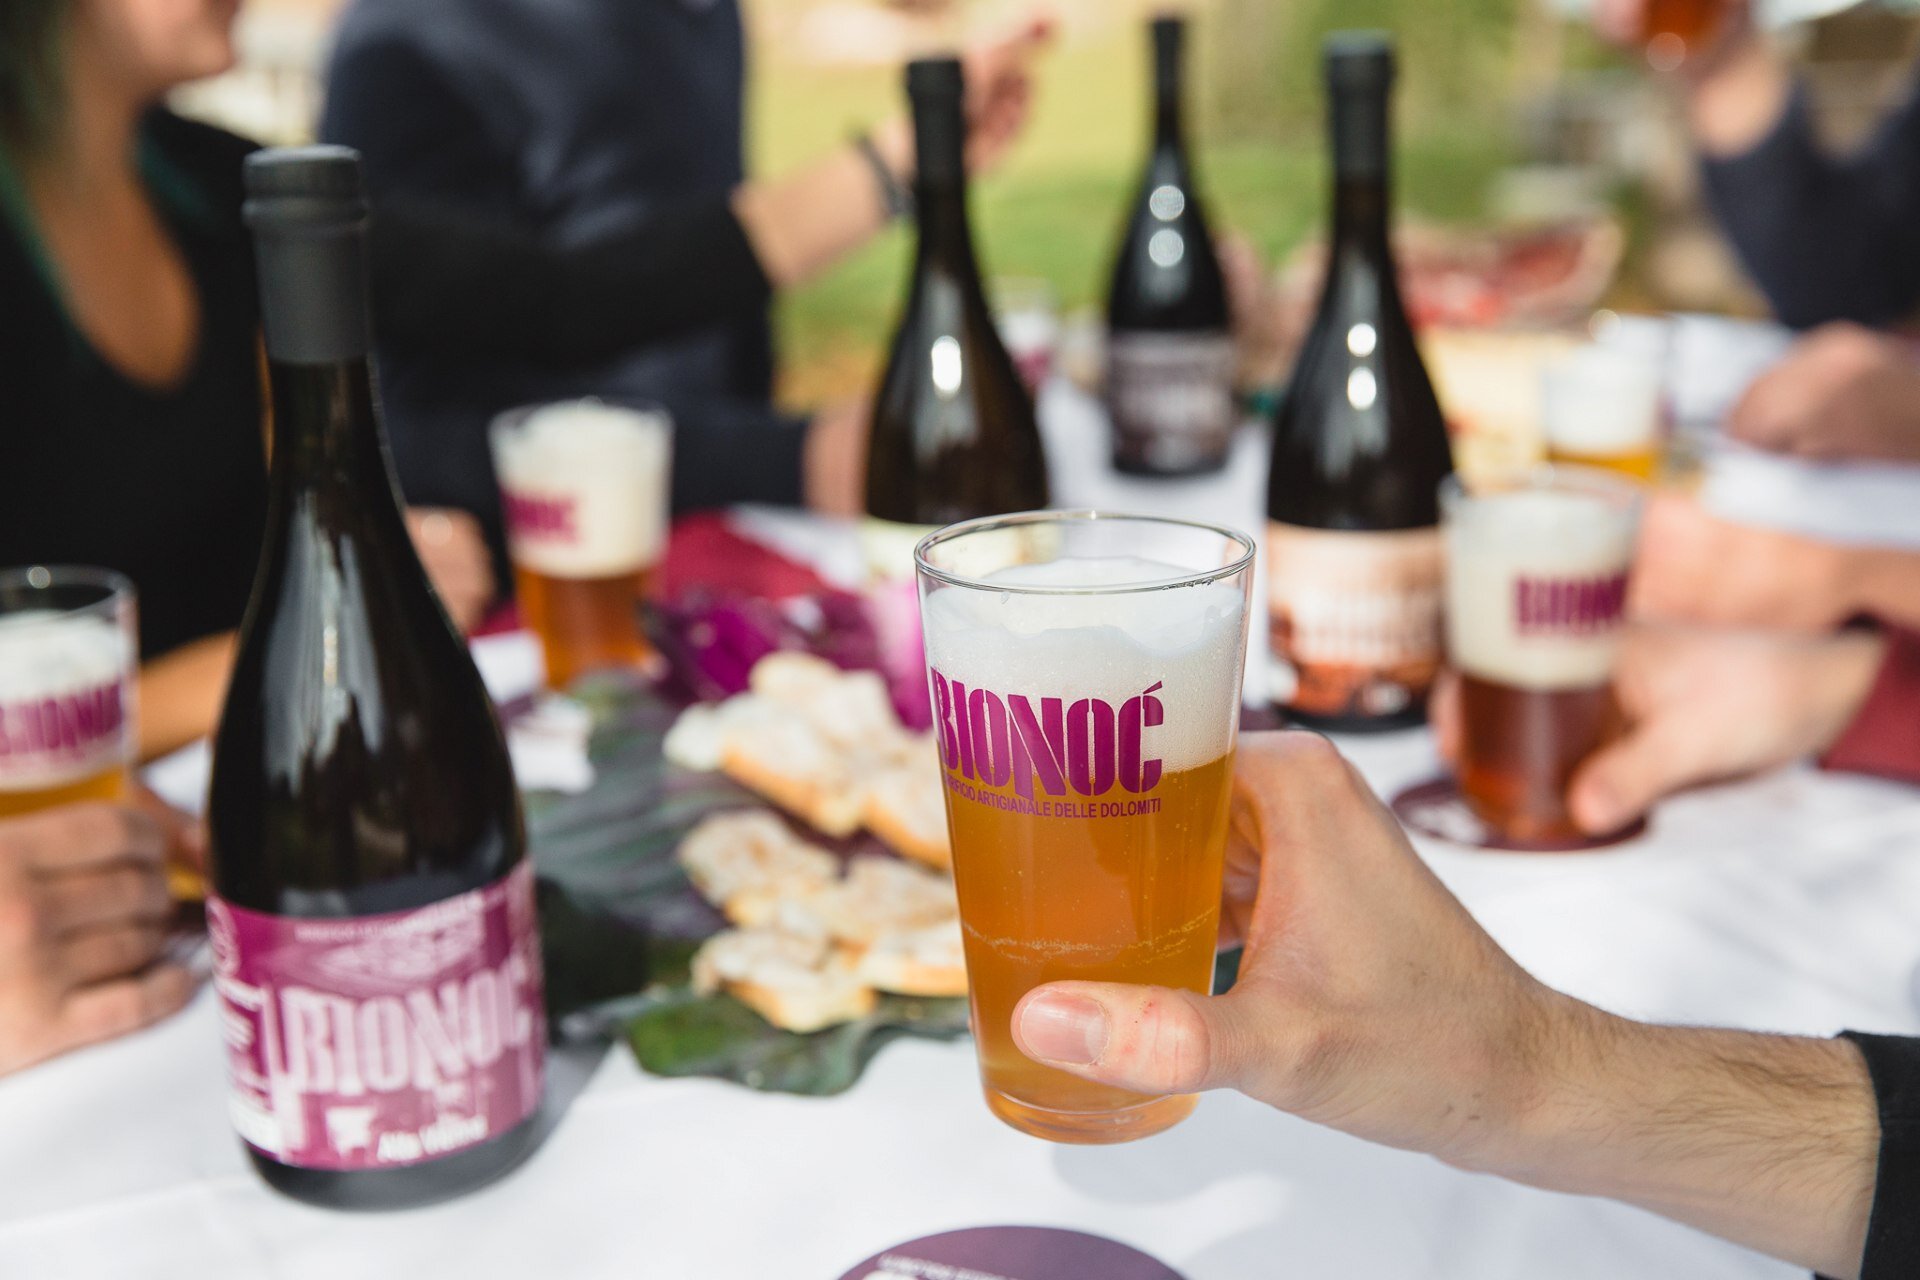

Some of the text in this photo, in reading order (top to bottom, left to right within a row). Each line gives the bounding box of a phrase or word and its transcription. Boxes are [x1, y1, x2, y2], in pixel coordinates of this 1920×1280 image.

[977, 789, 1051, 817] ARTIGIANALE
[1055, 802, 1097, 818] DELLE
[1101, 798, 1161, 818] DOLOMITI
